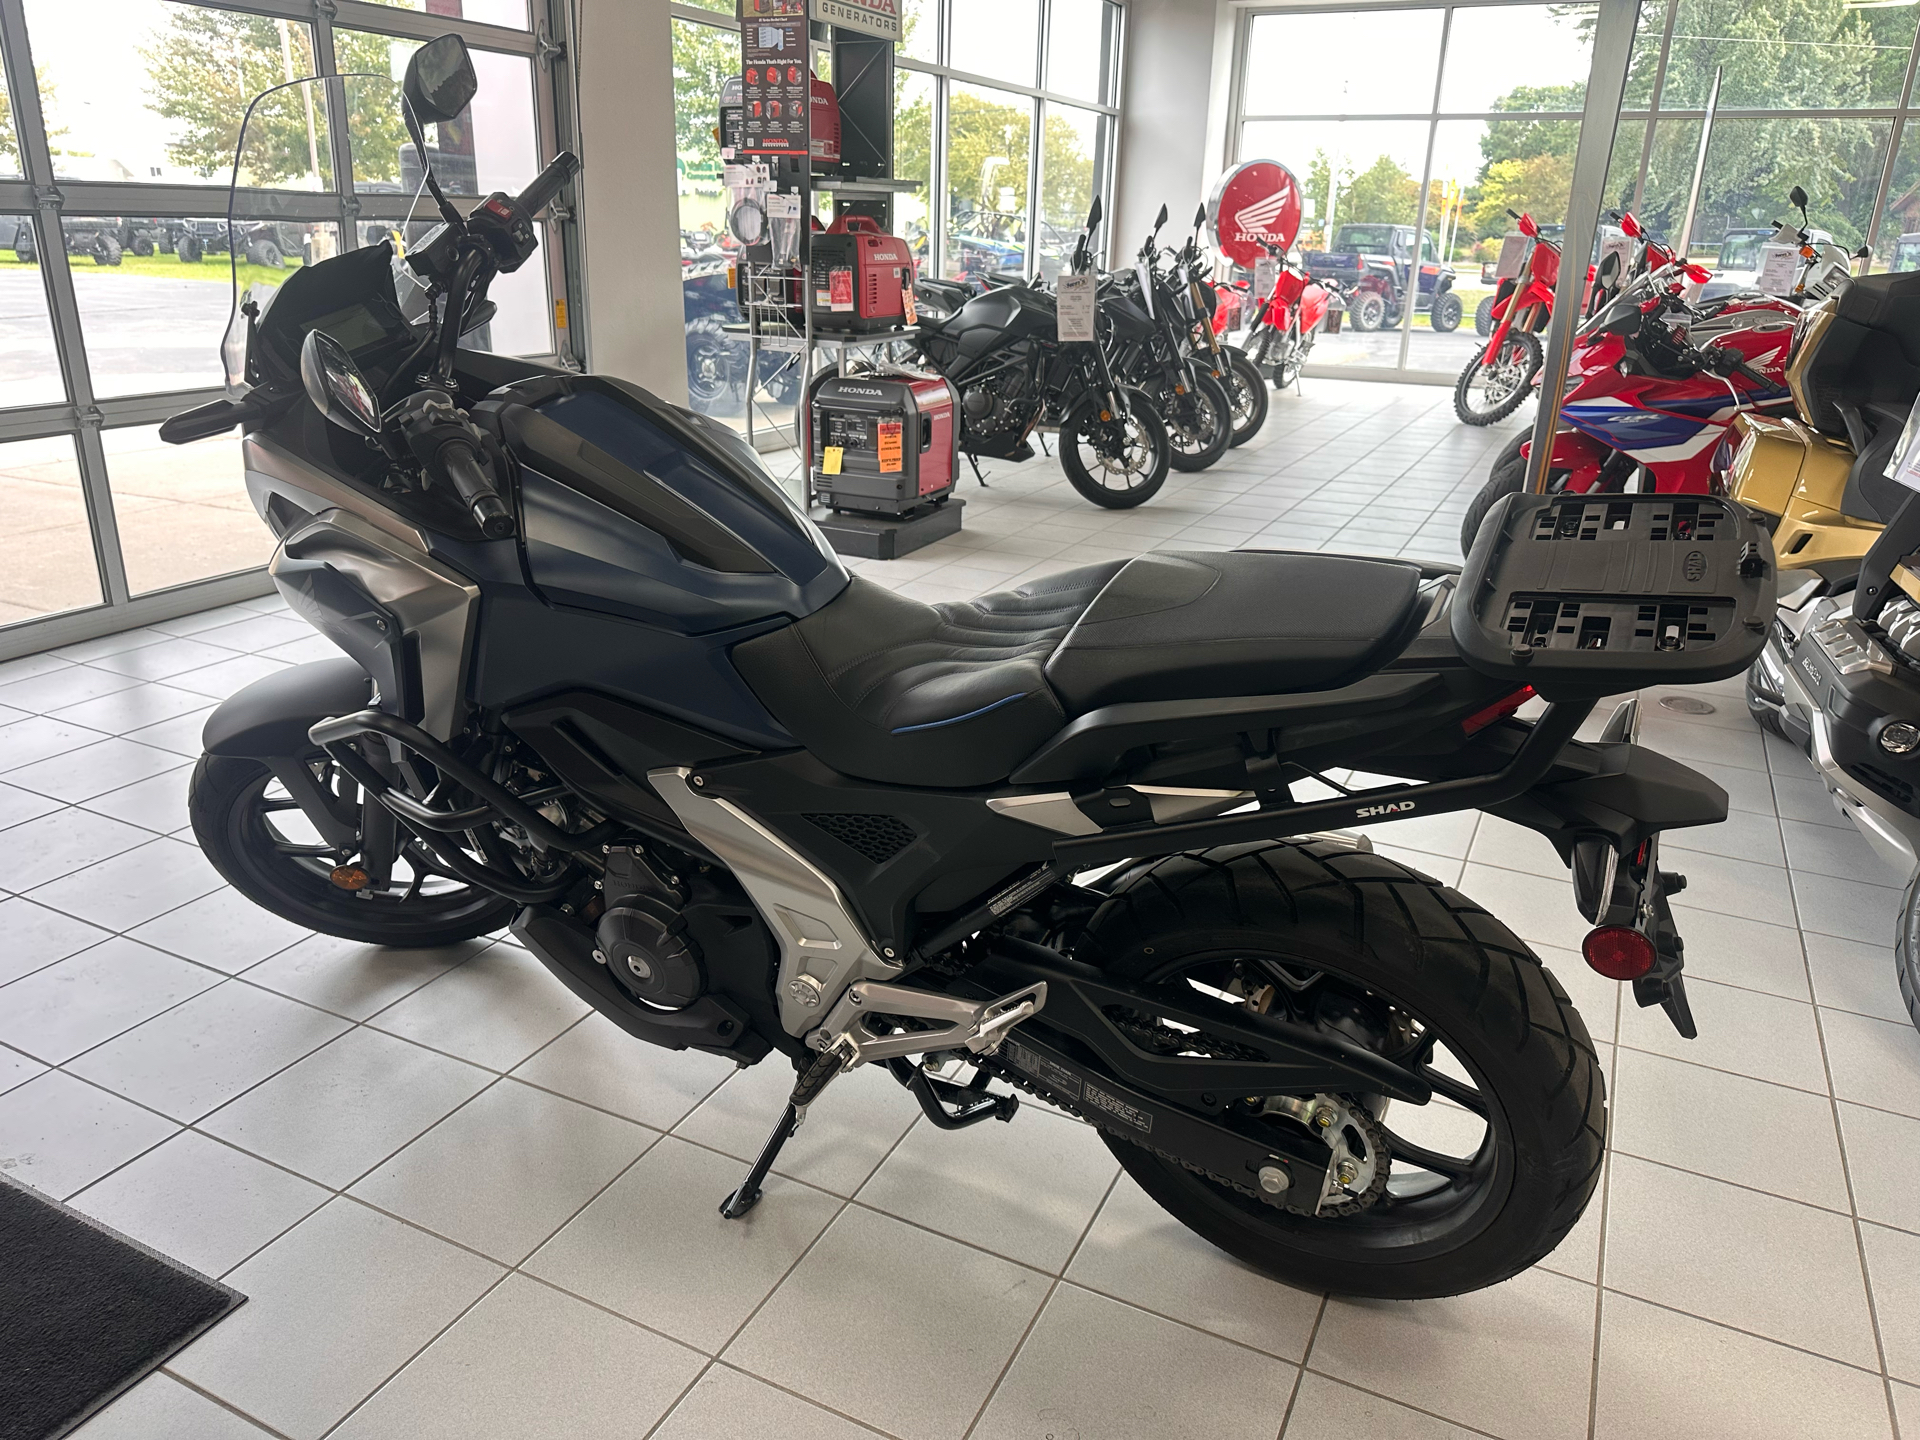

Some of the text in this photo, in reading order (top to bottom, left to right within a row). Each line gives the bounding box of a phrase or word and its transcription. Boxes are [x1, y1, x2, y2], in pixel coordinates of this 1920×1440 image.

[822, 2, 897, 32] GENERATORS
[1234, 232, 1285, 242] HONDA
[873, 253, 898, 261] HONDA
[838, 386, 883, 396] HONDA
[933, 411, 951, 421] HONDA
[1686, 552, 1701, 581] SHAD
[1356, 800, 1416, 818] SHAD
